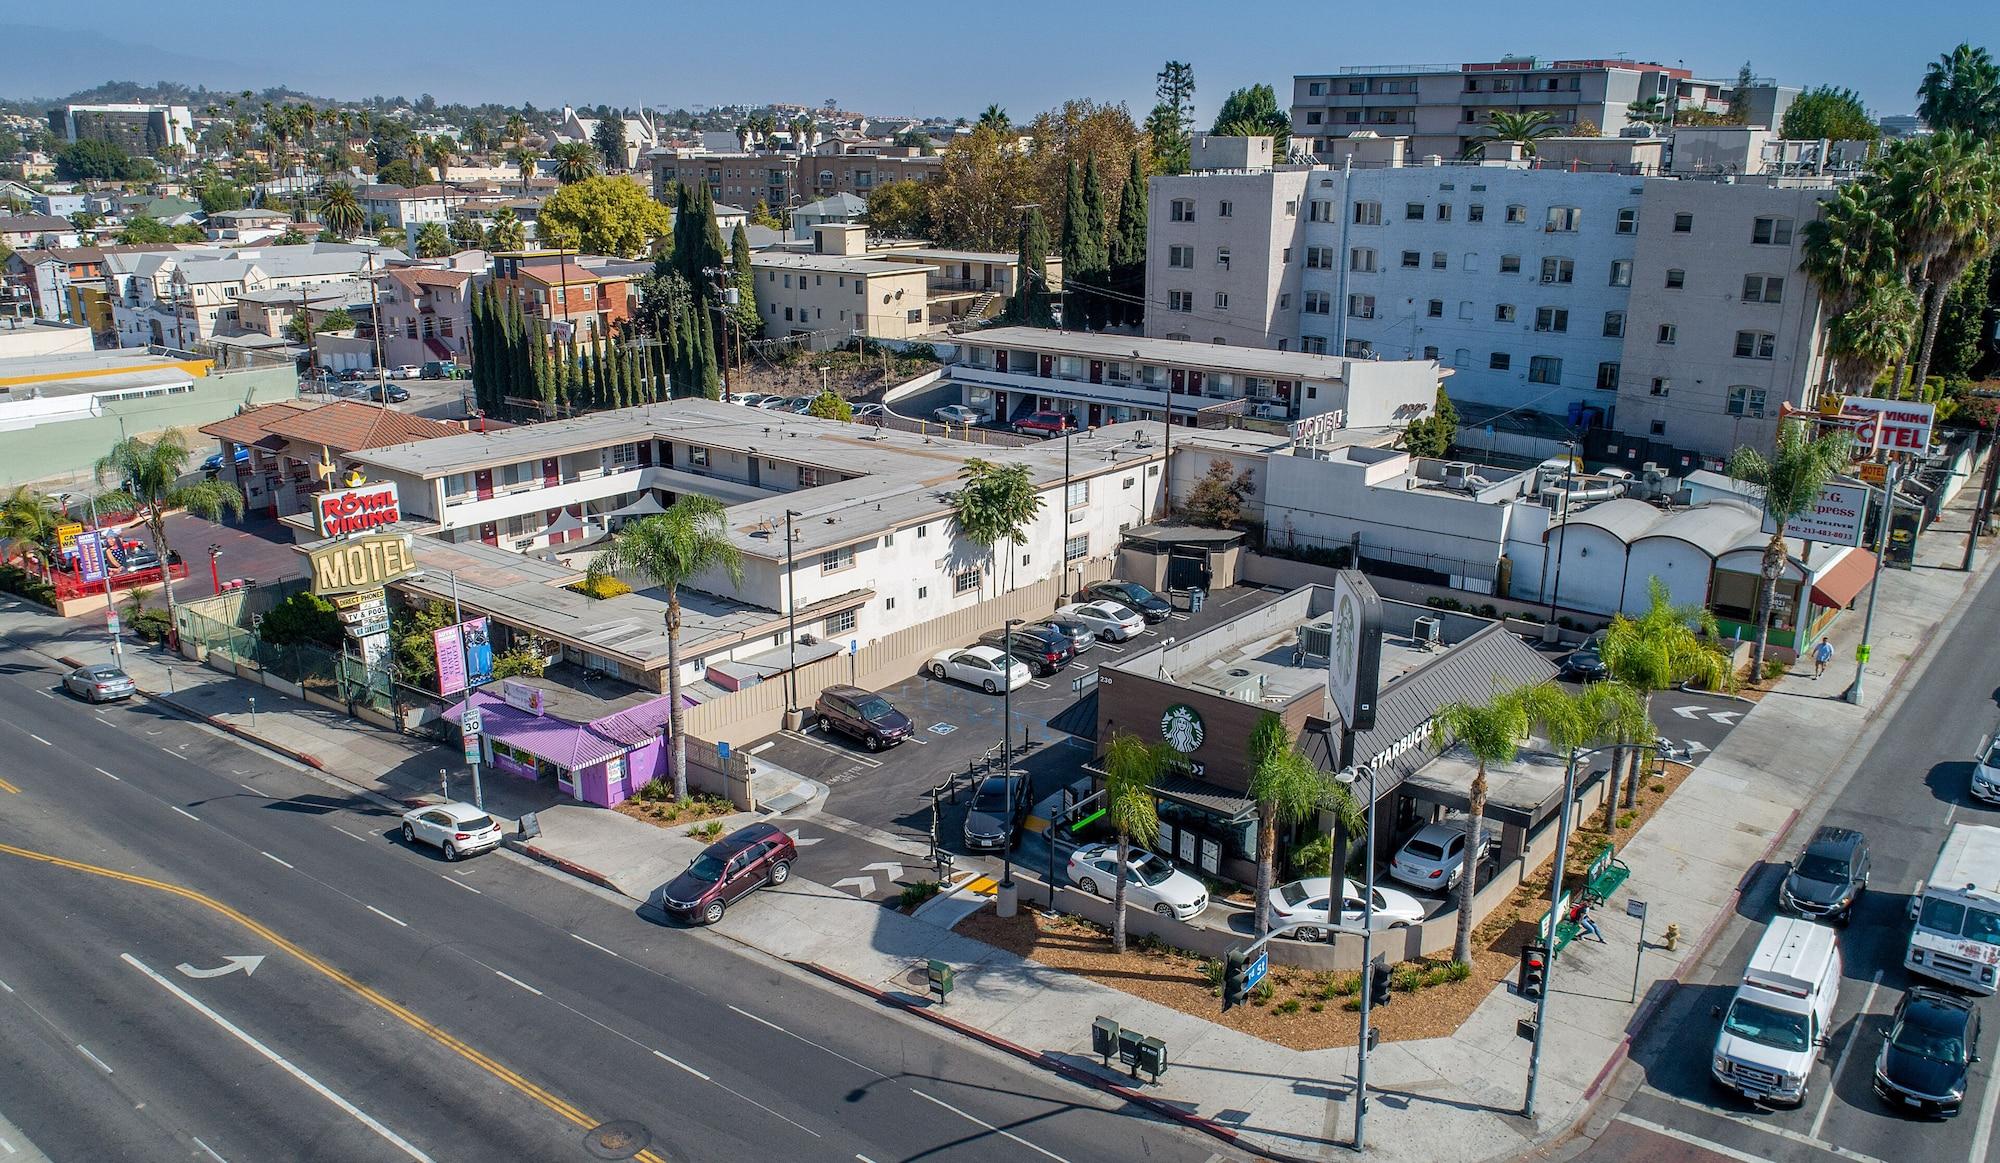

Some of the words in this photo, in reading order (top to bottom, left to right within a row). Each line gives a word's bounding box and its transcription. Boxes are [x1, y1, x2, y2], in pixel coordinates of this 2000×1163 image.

[1297, 409, 1343, 439] MOTEL
[1885, 411, 1929, 425] VIKING
[321, 491, 399, 518] ROYAL
[325, 508, 400, 536] VIKING
[1816, 520, 1854, 530] DELIVER
[319, 538, 415, 590] MOTEL
[339, 596, 359, 607] DIRECT
[361, 591, 384, 601] PHONES
[348, 613, 358, 621] TV
[360, 611, 365, 619] &
[368, 607, 386, 616] POOL
[1100, 676, 1113, 685] 230
[465, 721, 479, 732] 30
[1257, 961, 1266, 976] St
